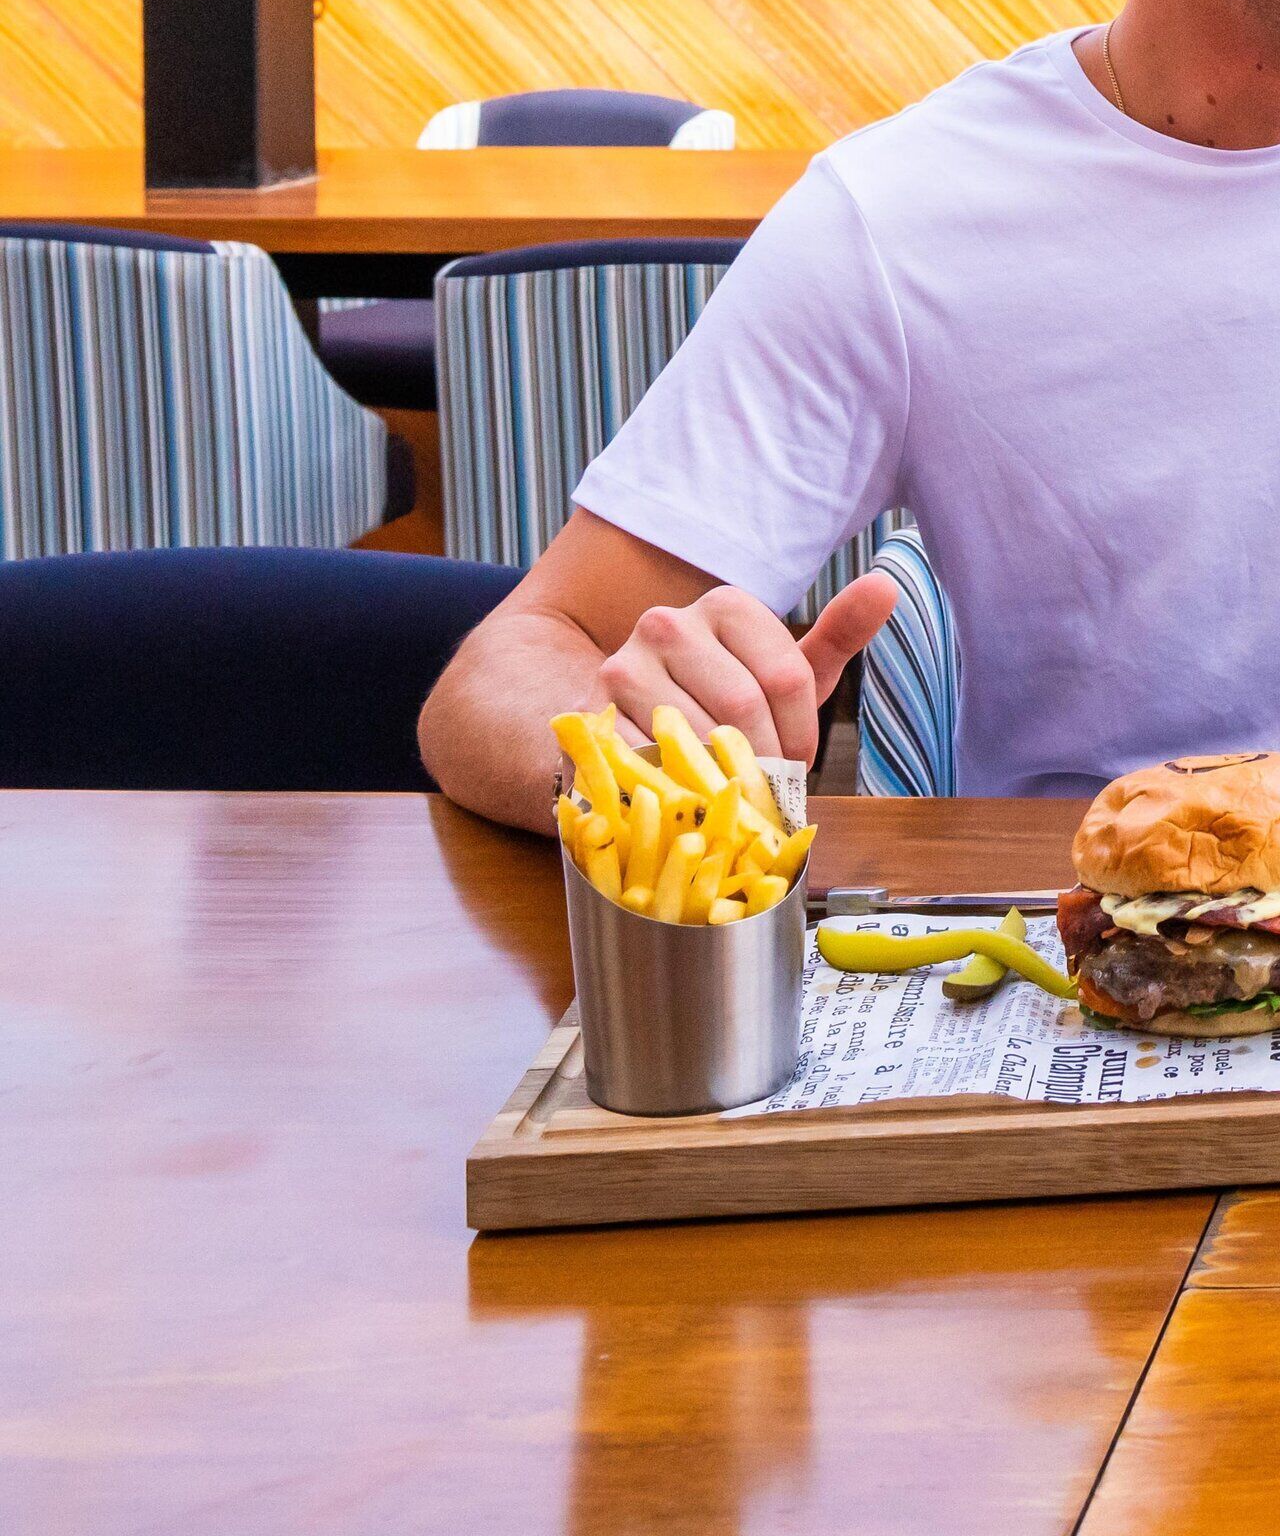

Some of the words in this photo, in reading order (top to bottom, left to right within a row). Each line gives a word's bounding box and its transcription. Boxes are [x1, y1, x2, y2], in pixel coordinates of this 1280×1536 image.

[858, 996, 878, 1014] mes
[884, 964, 933, 1049] commissaire
[800, 1018, 819, 1045] une
[827, 1021, 847, 1037] la
[1007, 1037, 1032, 1049] Le
[874, 1064, 903, 1075] à
[1164, 1066, 1179, 1078] ce
